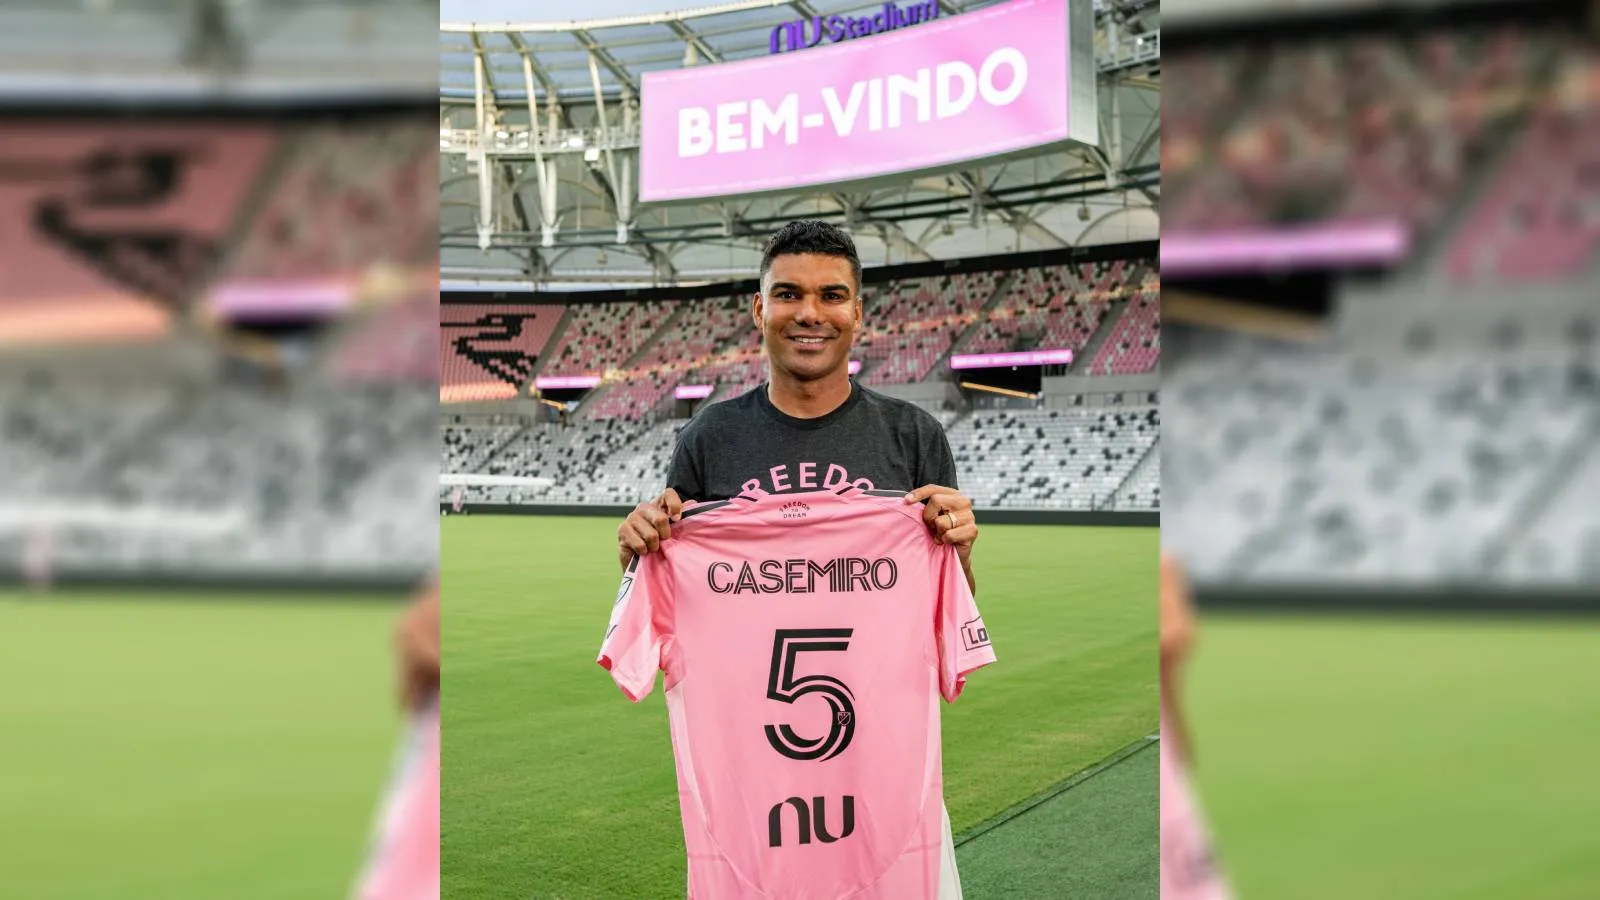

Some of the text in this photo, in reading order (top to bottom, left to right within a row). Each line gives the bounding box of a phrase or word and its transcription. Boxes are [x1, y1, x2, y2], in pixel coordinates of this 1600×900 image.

[826, 0, 939, 43] Stadium
[678, 47, 1028, 158] BEM-VINDO
[707, 557, 898, 594] CASEMIRO
[764, 628, 856, 762] 5
